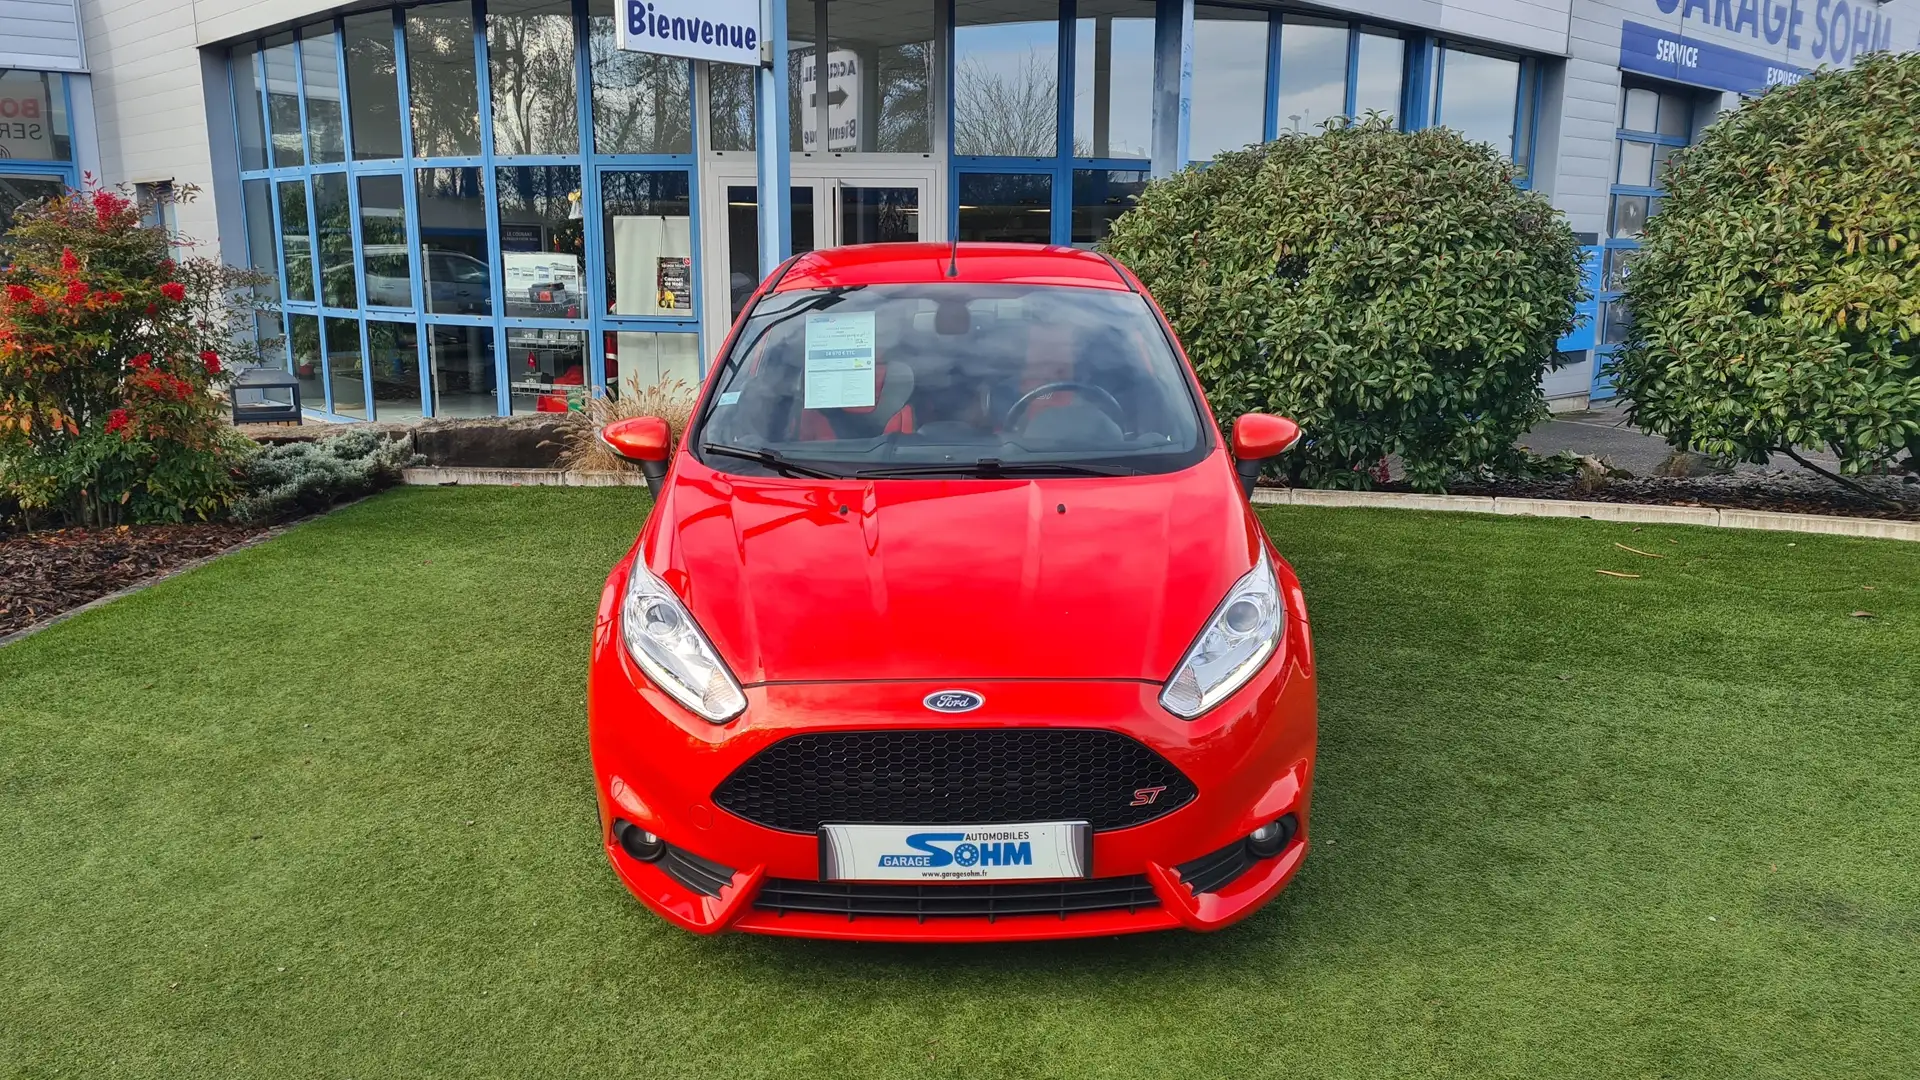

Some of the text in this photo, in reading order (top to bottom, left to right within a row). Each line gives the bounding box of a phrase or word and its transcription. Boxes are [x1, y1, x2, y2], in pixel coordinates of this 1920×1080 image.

[627, 0, 757, 50] Bienvenue
[1656, 0, 1892, 65] AGE SOHM
[1656, 38, 1699, 68] SERVICE
[936, 695, 970, 708] Ford
[1130, 786, 1167, 806] ST
[965, 832, 1029, 841] AUTOMOBILES
[905, 833, 1033, 868] SOHM
[883, 856, 931, 867] GARAGE
[921, 870, 988, 879] www.garagesohm.fr
